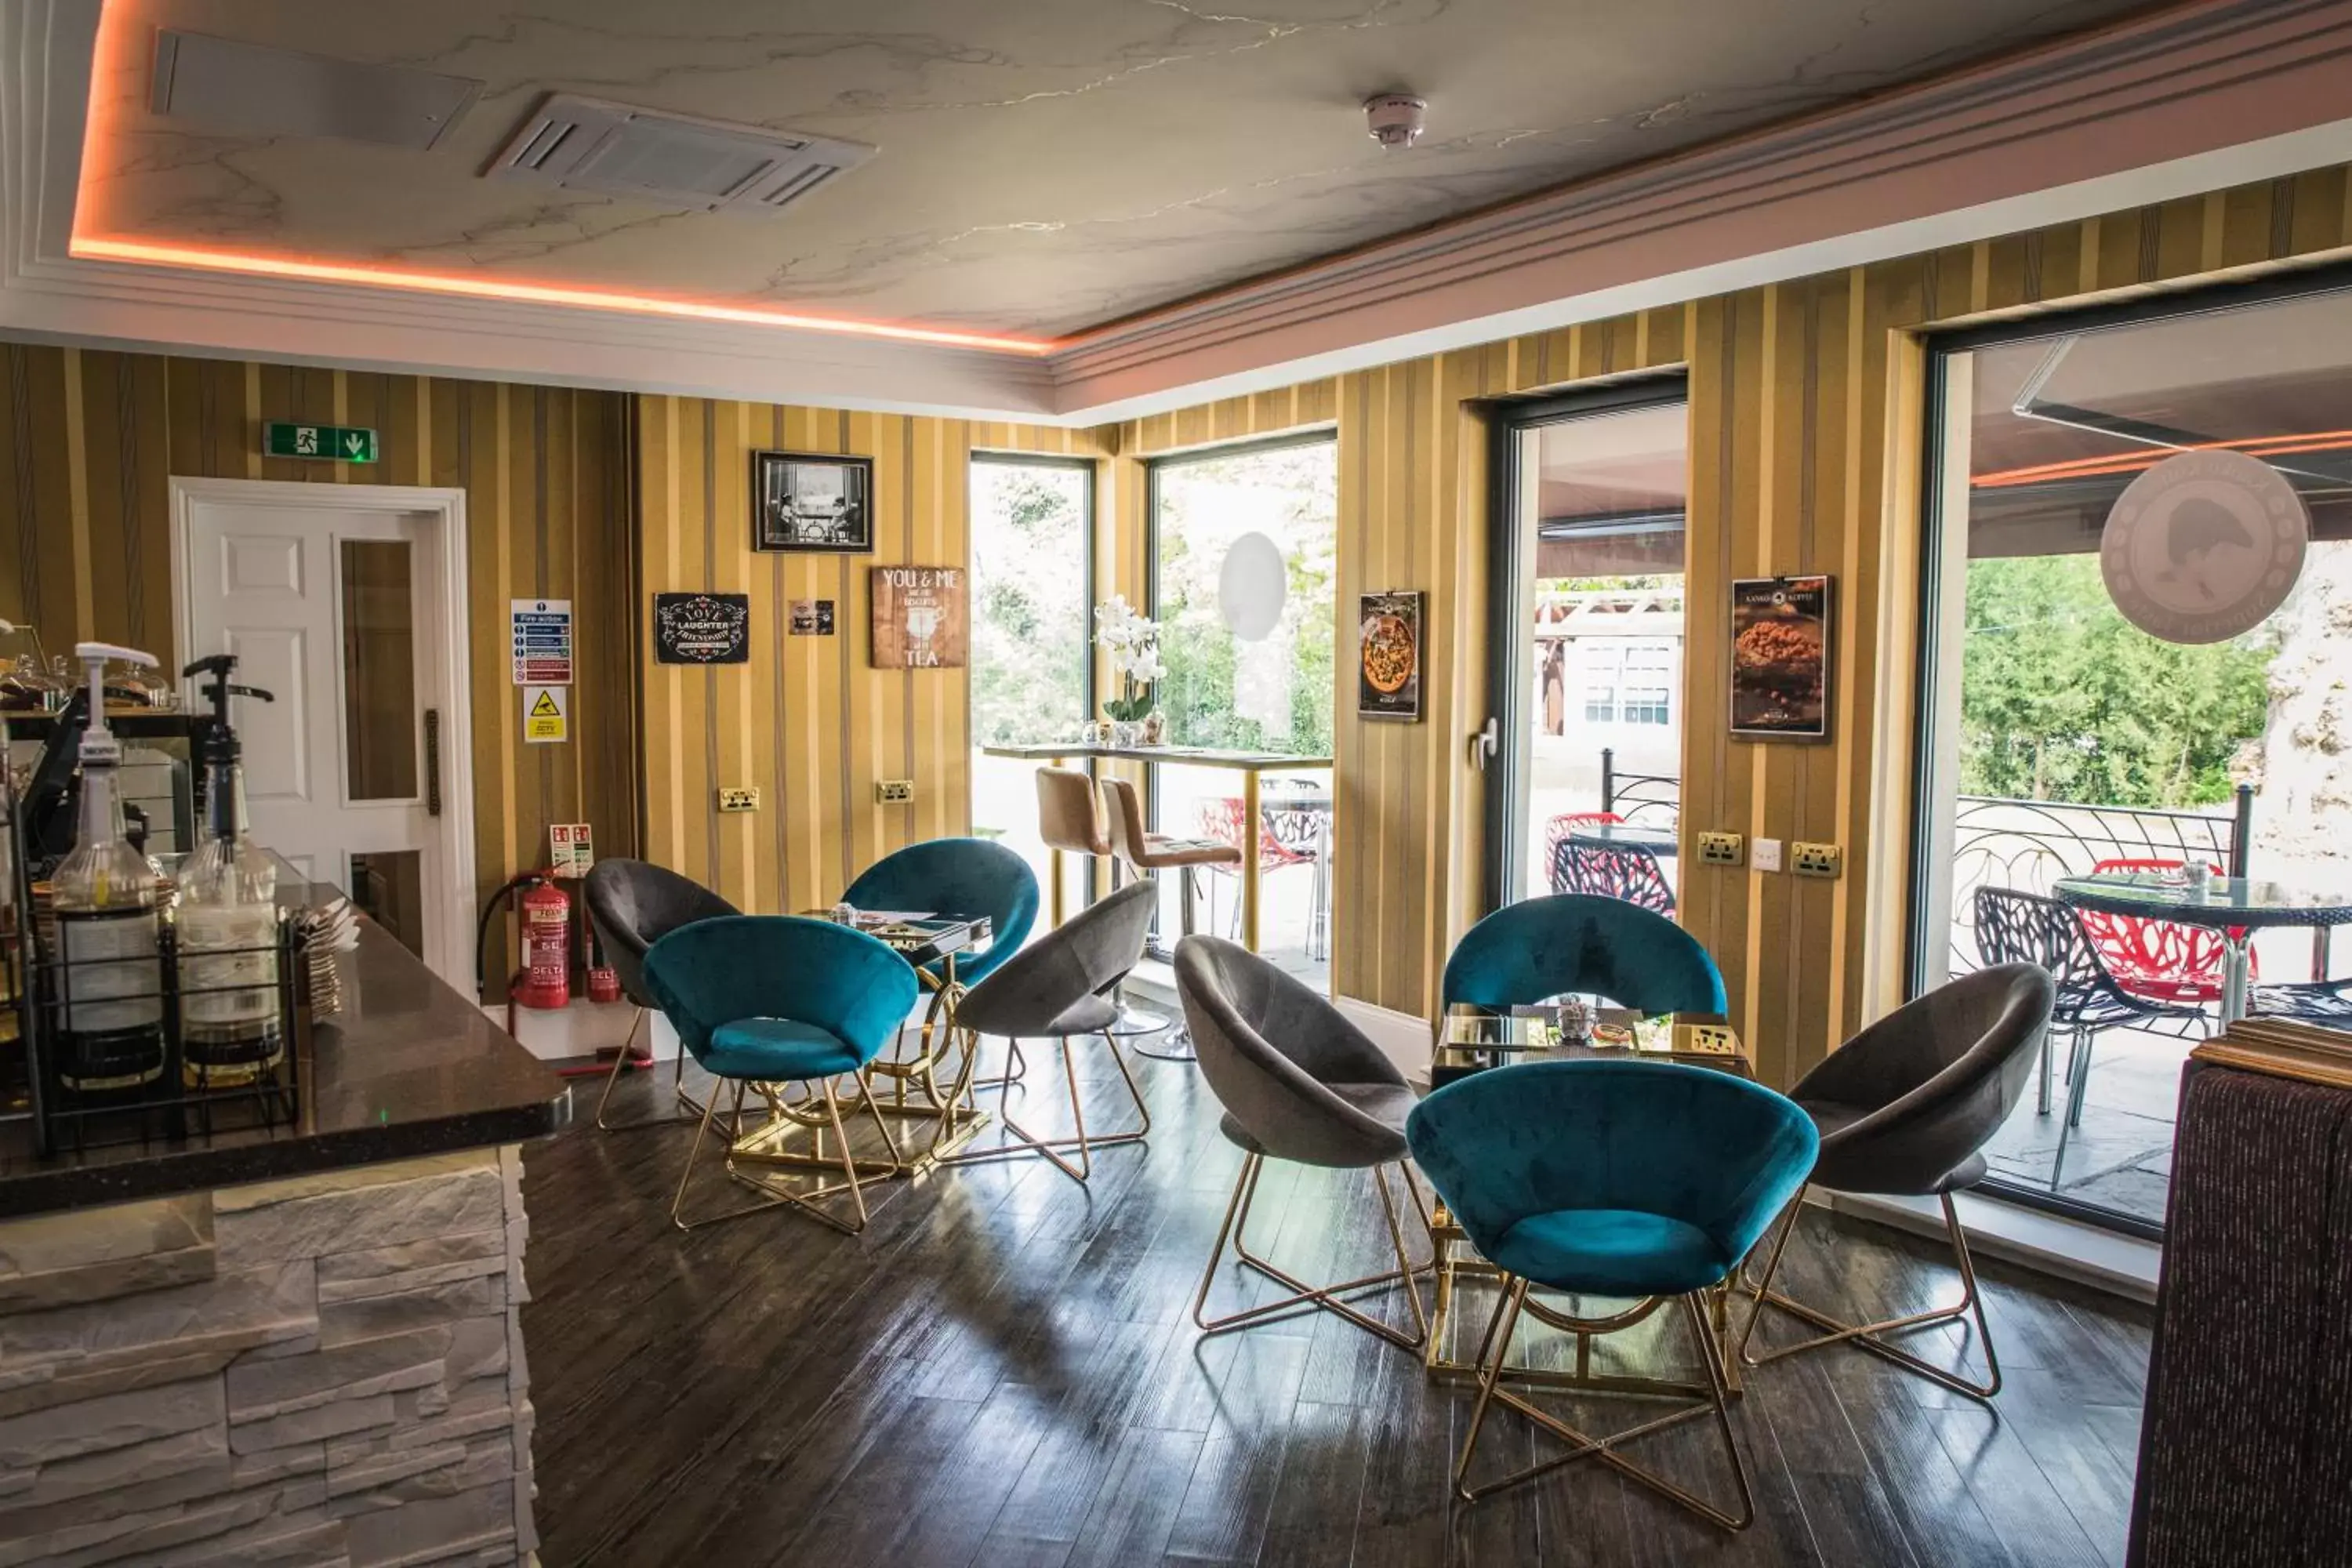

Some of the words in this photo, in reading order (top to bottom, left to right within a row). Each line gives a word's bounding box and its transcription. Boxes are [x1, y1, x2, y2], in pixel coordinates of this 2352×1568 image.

[884, 569, 916, 588] YOU
[921, 571, 932, 588] &
[935, 569, 957, 589] ME
[904, 650, 938, 666] TEA
